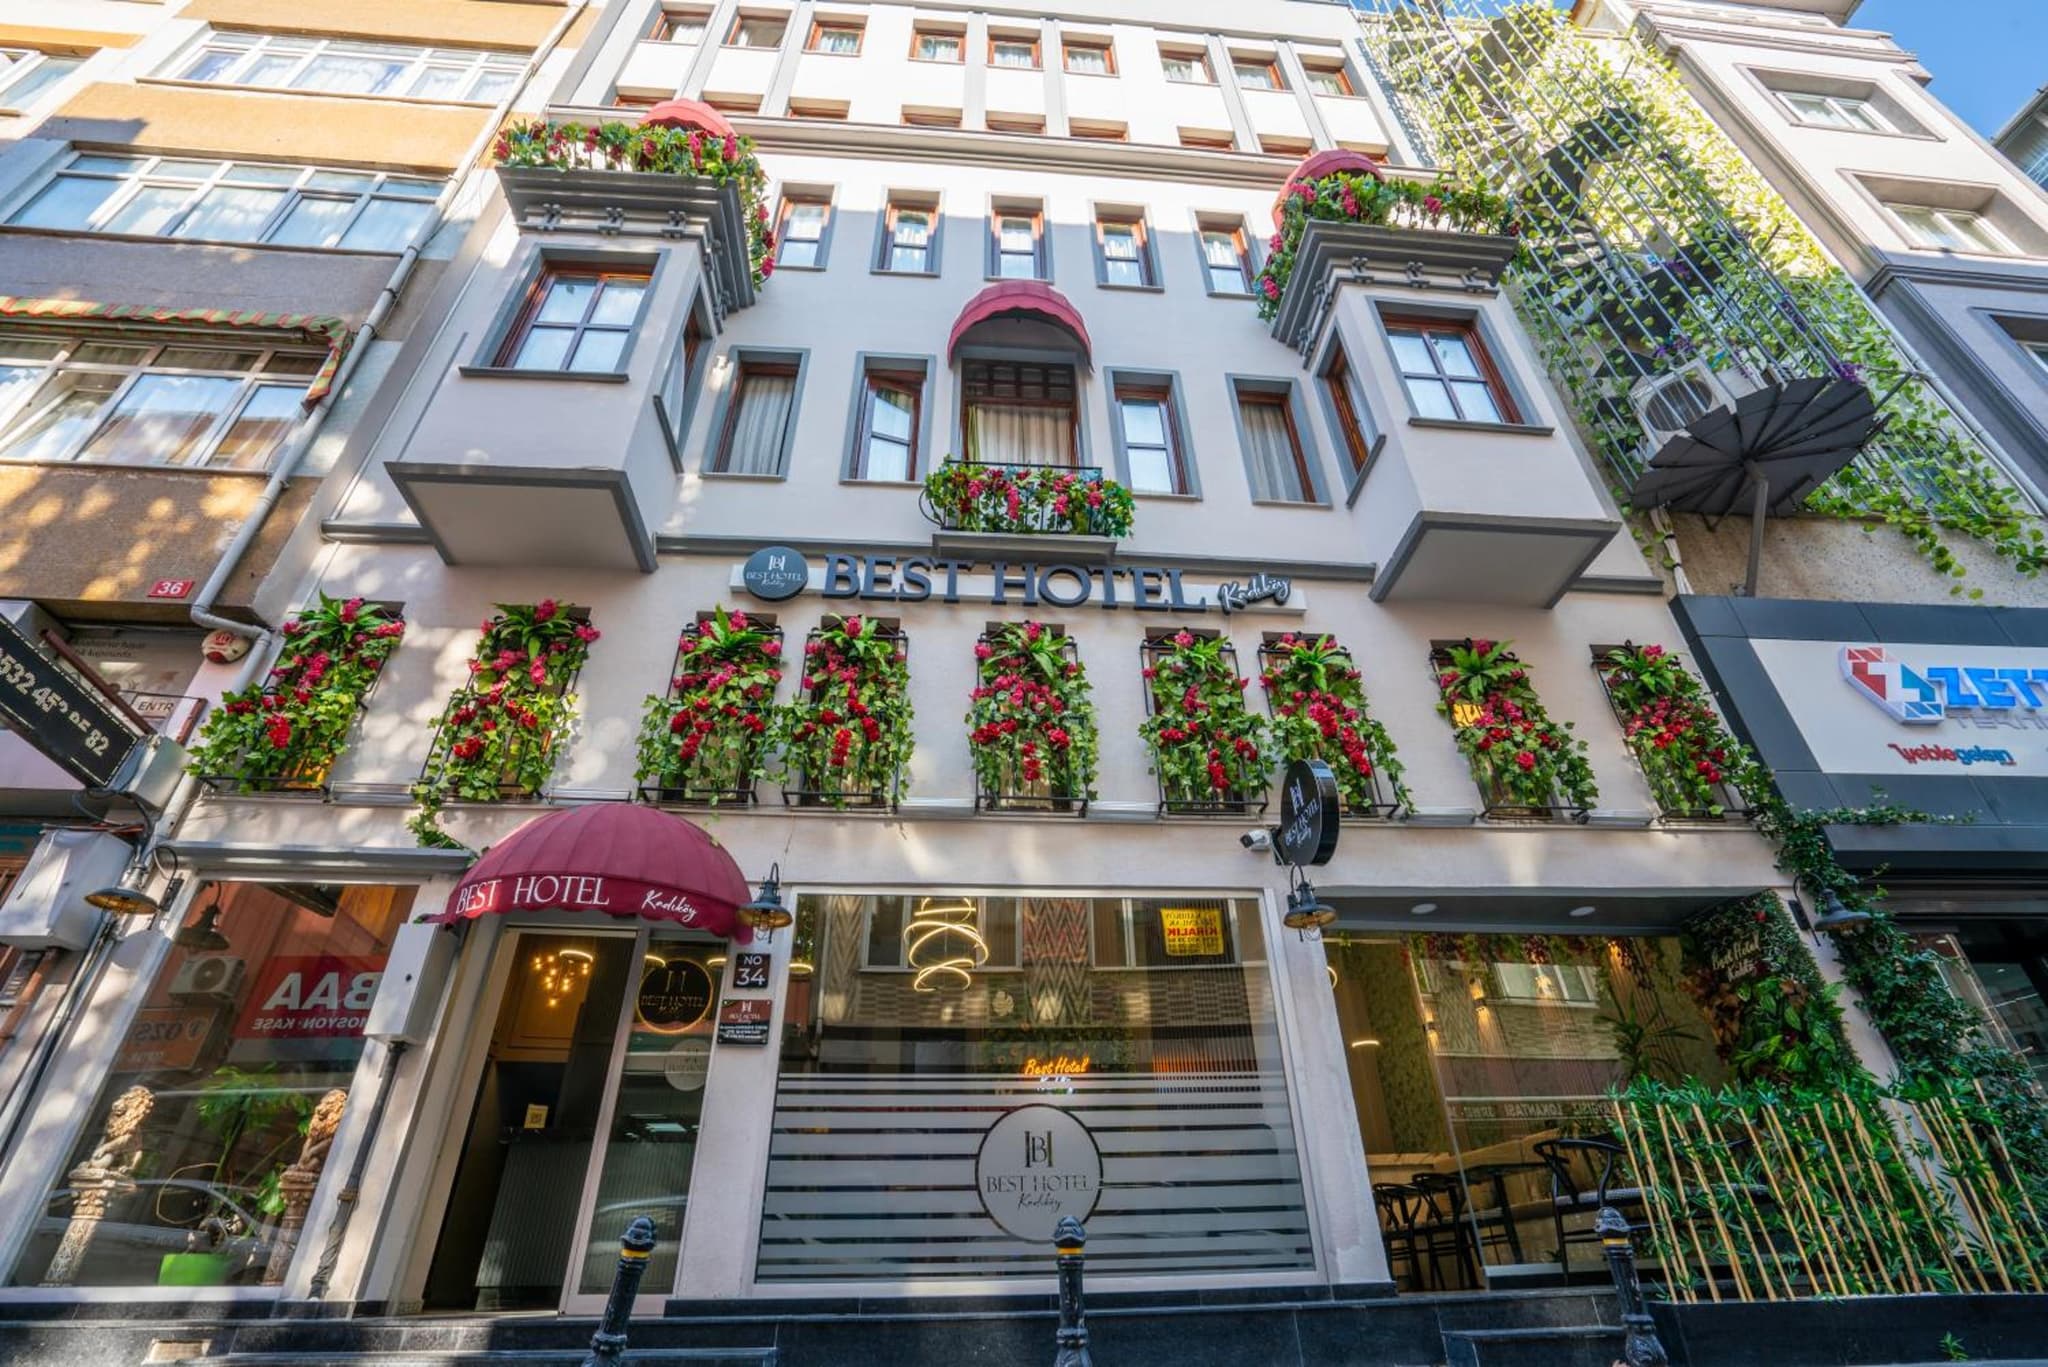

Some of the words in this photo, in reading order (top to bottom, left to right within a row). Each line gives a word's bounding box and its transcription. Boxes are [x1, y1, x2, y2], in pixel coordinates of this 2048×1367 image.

[157, 582, 184, 595] 36
[822, 554, 974, 604] BEST
[992, 561, 1207, 611] HOTEL
[0, 647, 36, 695] 532
[85, 729, 110, 757] 82
[456, 879, 502, 914] BEST
[513, 875, 610, 906] HOTEL
[641, 889, 697, 922] Kadıköy
[744, 956, 762, 965] NO
[736, 968, 765, 985] 34
[1024, 1058, 1054, 1075] Best
[1056, 1055, 1089, 1074] Hotel
[987, 1175, 1027, 1192] BEST
[1033, 1175, 1093, 1192] HOTEL
